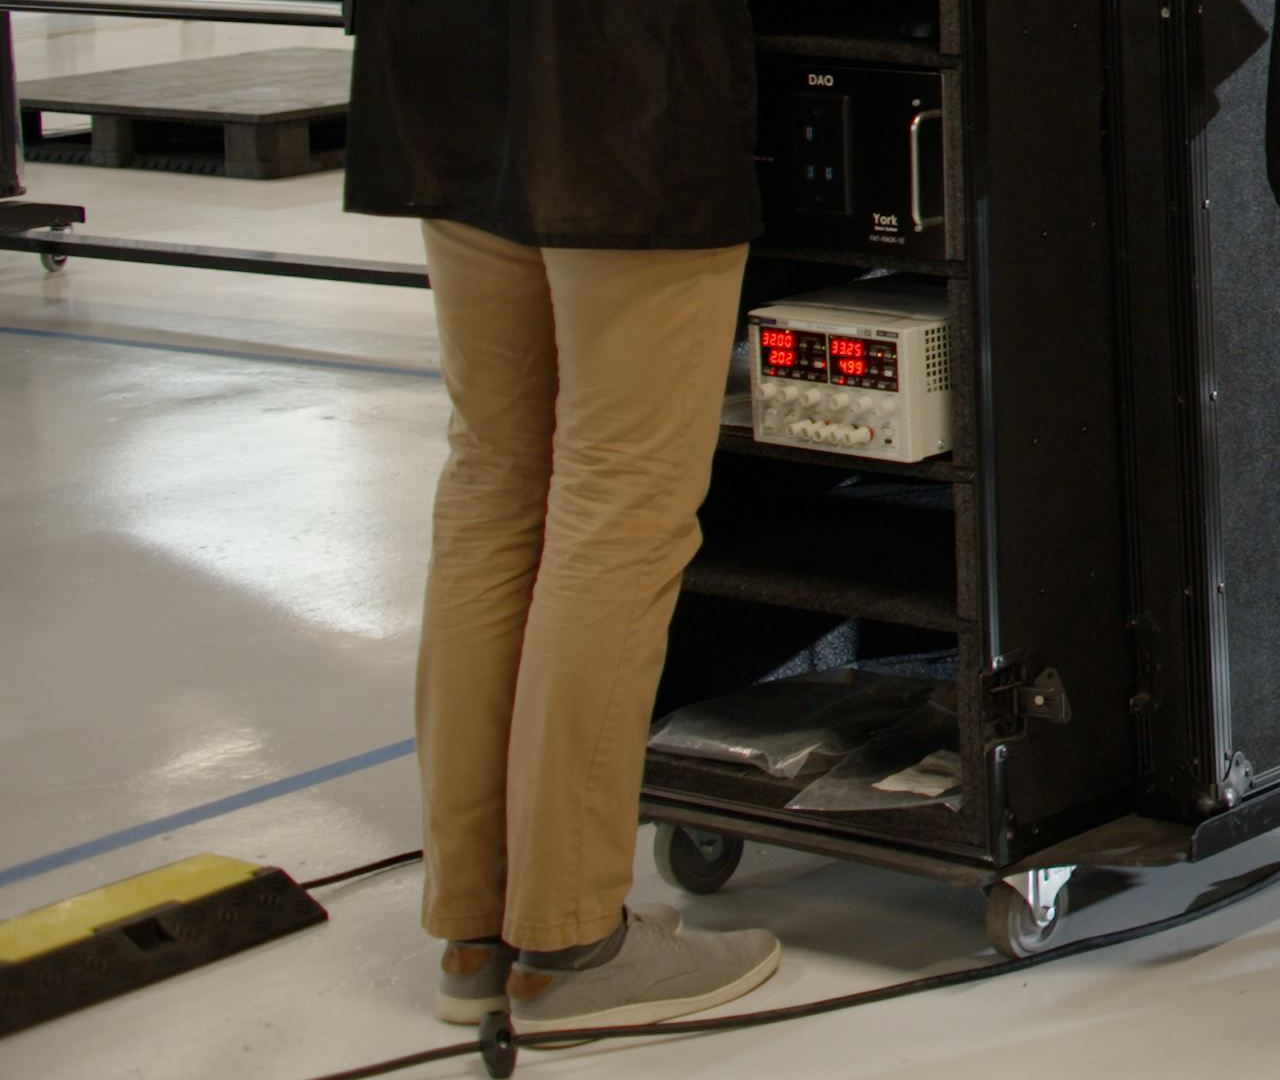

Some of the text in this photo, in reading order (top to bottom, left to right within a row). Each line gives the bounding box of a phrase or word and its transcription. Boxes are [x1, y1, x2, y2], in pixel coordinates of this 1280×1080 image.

[808, 74, 834, 87] DAQ
[873, 213, 898, 226] York
[832, 341, 862, 356] 33.25
[770, 350, 793, 365] 2.02
